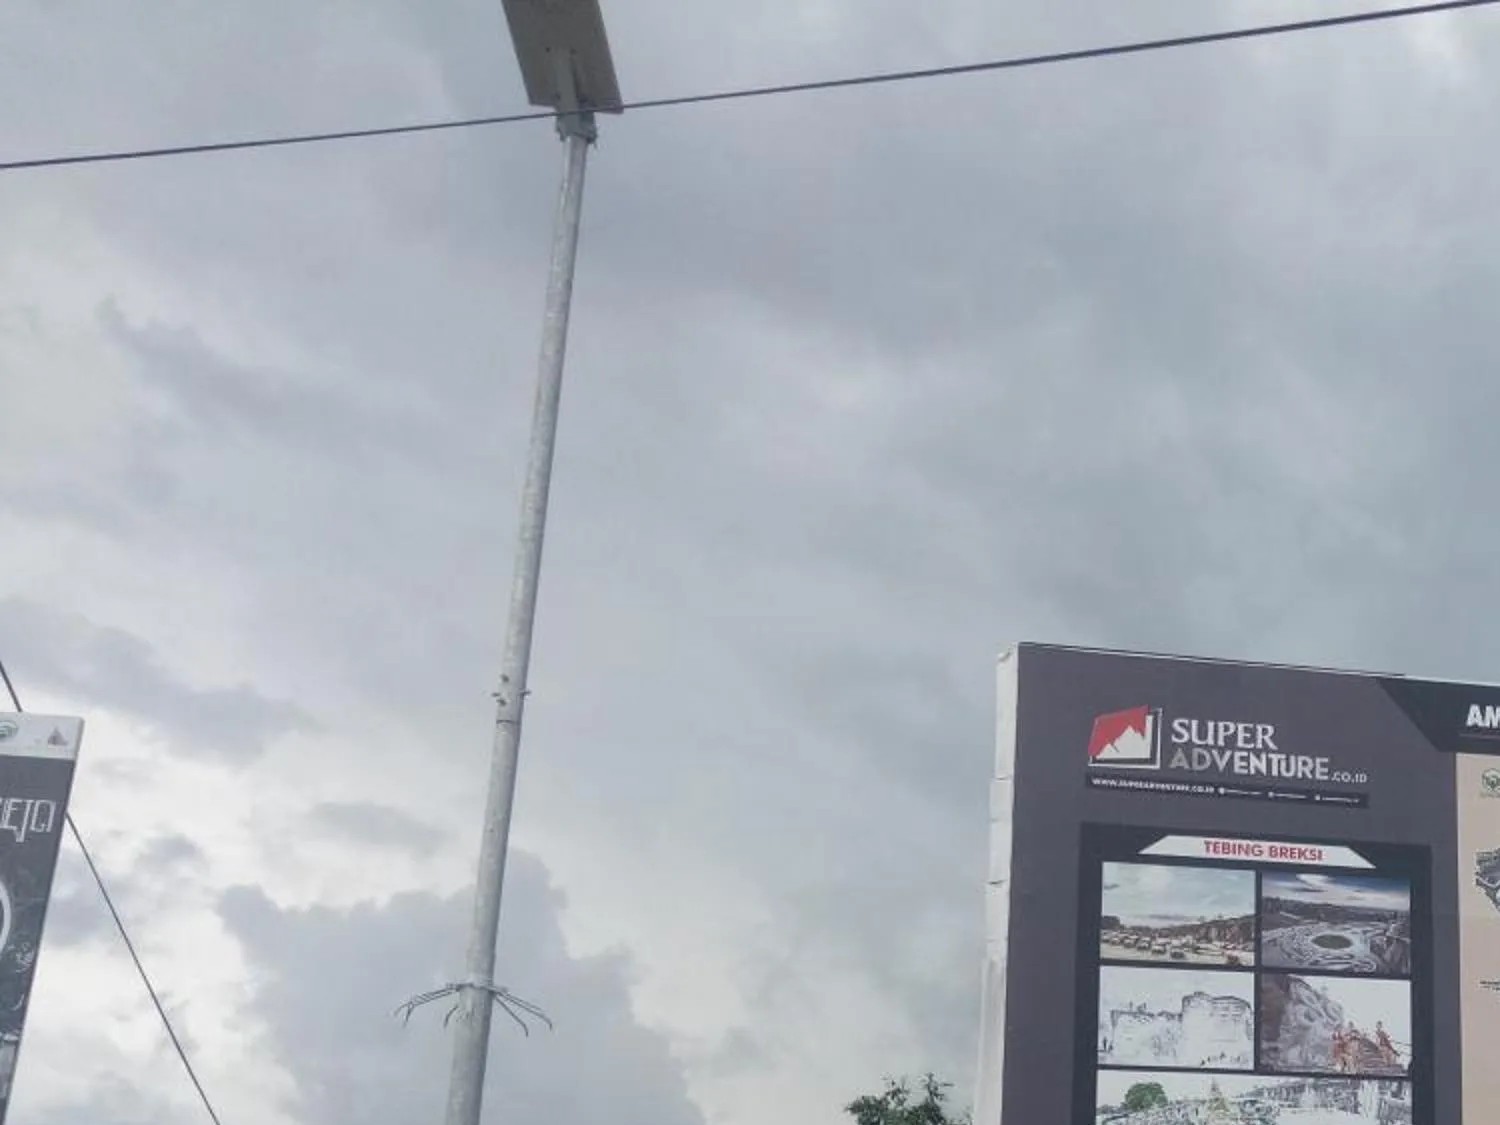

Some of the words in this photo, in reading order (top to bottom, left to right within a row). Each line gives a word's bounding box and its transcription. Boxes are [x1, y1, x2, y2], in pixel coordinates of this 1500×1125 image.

[1171, 718, 1279, 750] SUPER
[1203, 840, 1264, 857] TEBING
[1268, 844, 1324, 861] BREKSI
